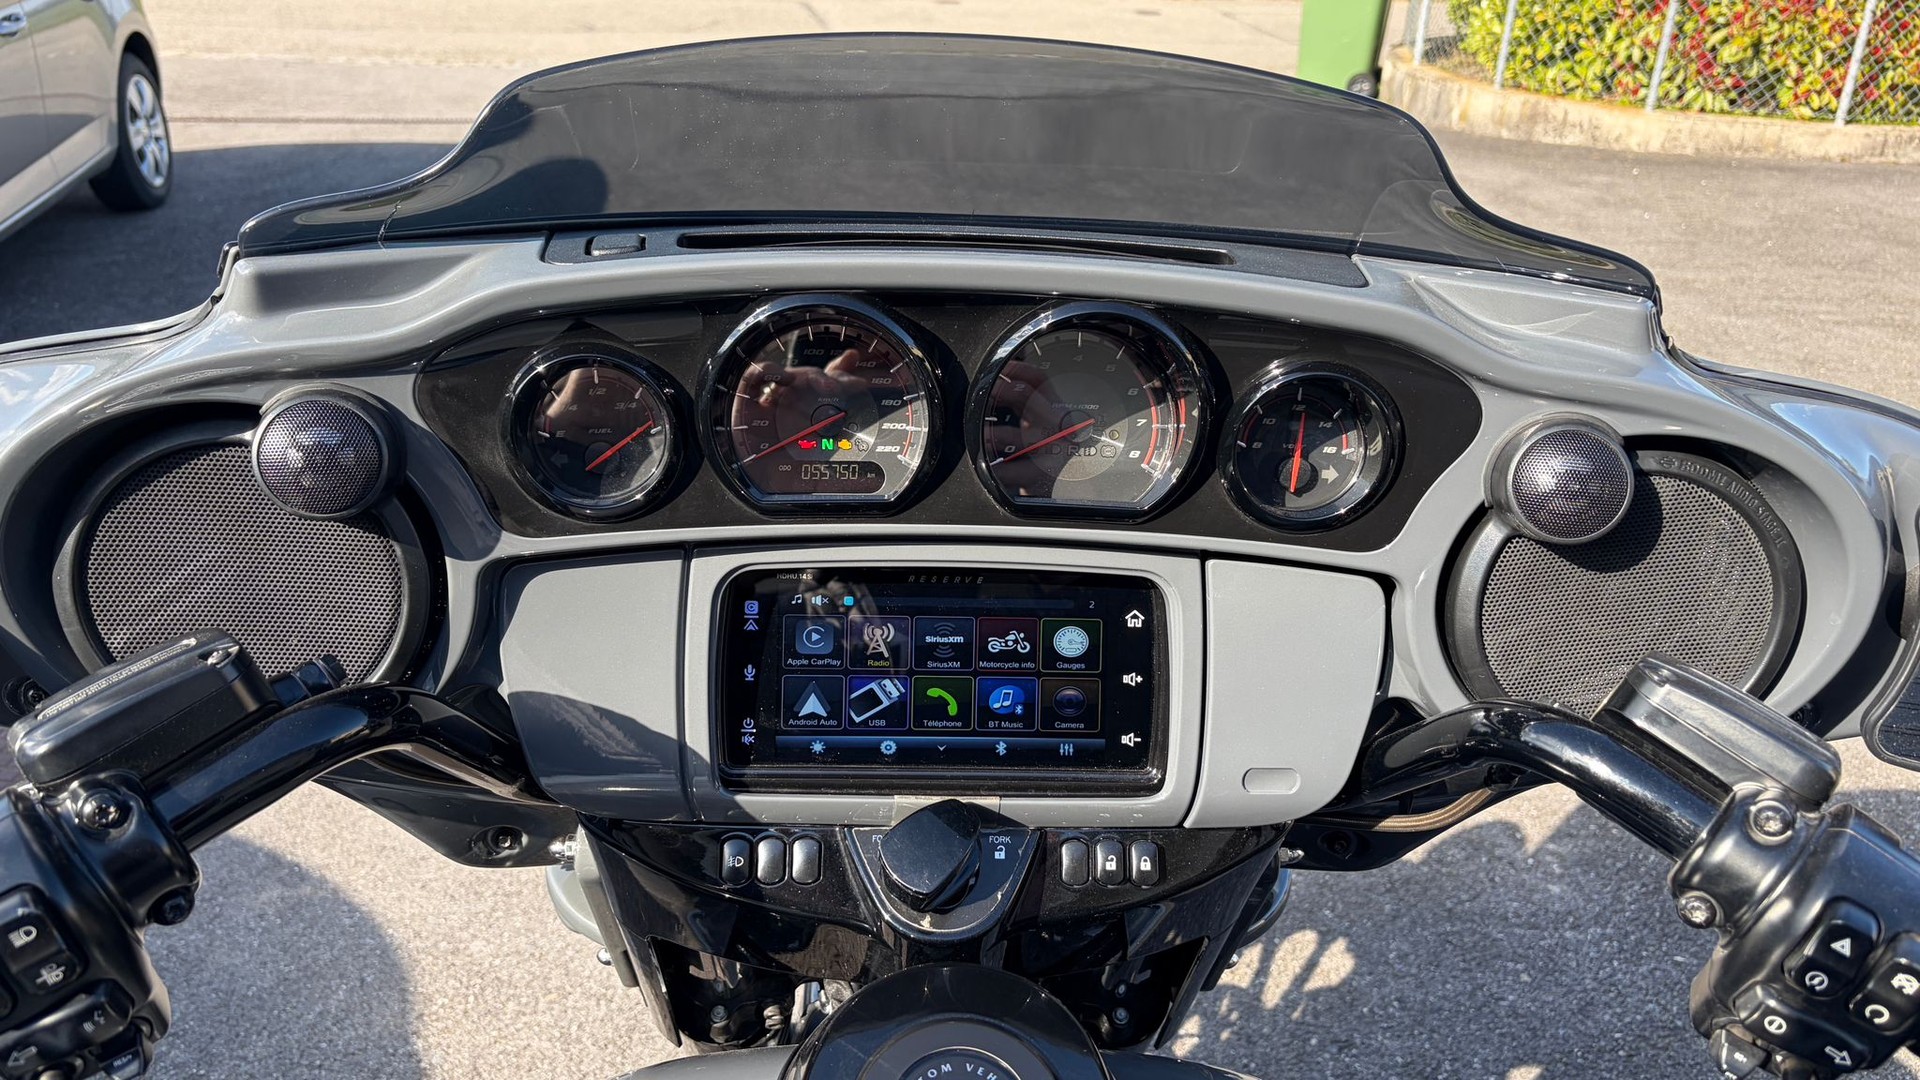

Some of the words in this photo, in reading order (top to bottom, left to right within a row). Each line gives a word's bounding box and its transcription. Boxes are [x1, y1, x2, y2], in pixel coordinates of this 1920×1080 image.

[1072, 354, 1083, 362] 4
[1039, 362, 1050, 370] 3
[871, 377, 892, 385] 160
[588, 386, 608, 396] 1/2
[1014, 383, 1025, 391] 2
[1127, 387, 1139, 396] 6
[614, 401, 637, 411] 3/4
[880, 399, 902, 407] 180
[1003, 414, 1012, 422] 1
[1135, 418, 1148, 427] 7
[1262, 417, 1277, 425] 10
[751, 419, 770, 427] 20
[881, 422, 907, 430] 200
[1318, 421, 1333, 429] 14
[556, 430, 566, 438] E
[760, 442, 770, 450] 0
[821, 438, 834, 450] N
[875, 444, 901, 453] 220
[1004, 445, 1016, 453] 0
[1322, 446, 1338, 454] 16
[1128, 450, 1141, 459] 8
[801, 464, 859, 480] 055750
[1726, 480, 1759, 509] AUDIO
[907, 574, 985, 585] RESERVE
[1088, 600, 1096, 609] 2
[786, 657, 809, 667] Apple
[811, 657, 842, 668] CarPlay
[867, 658, 890, 668] Radio
[926, 660, 961, 669] SiriusXM
[979, 660, 1020, 670] Motorcycle
[1021, 660, 1036, 669] info
[1056, 661, 1086, 671] Gauges
[788, 718, 818, 727] Android
[819, 718, 838, 727] Auto
[868, 718, 886, 728] USB
[923, 718, 962, 729] Téléphone
[988, 720, 1000, 729] BT
[1001, 720, 1024, 729] Music
[1054, 721, 1085, 730] Camera
[988, 835, 1012, 845] FORK
